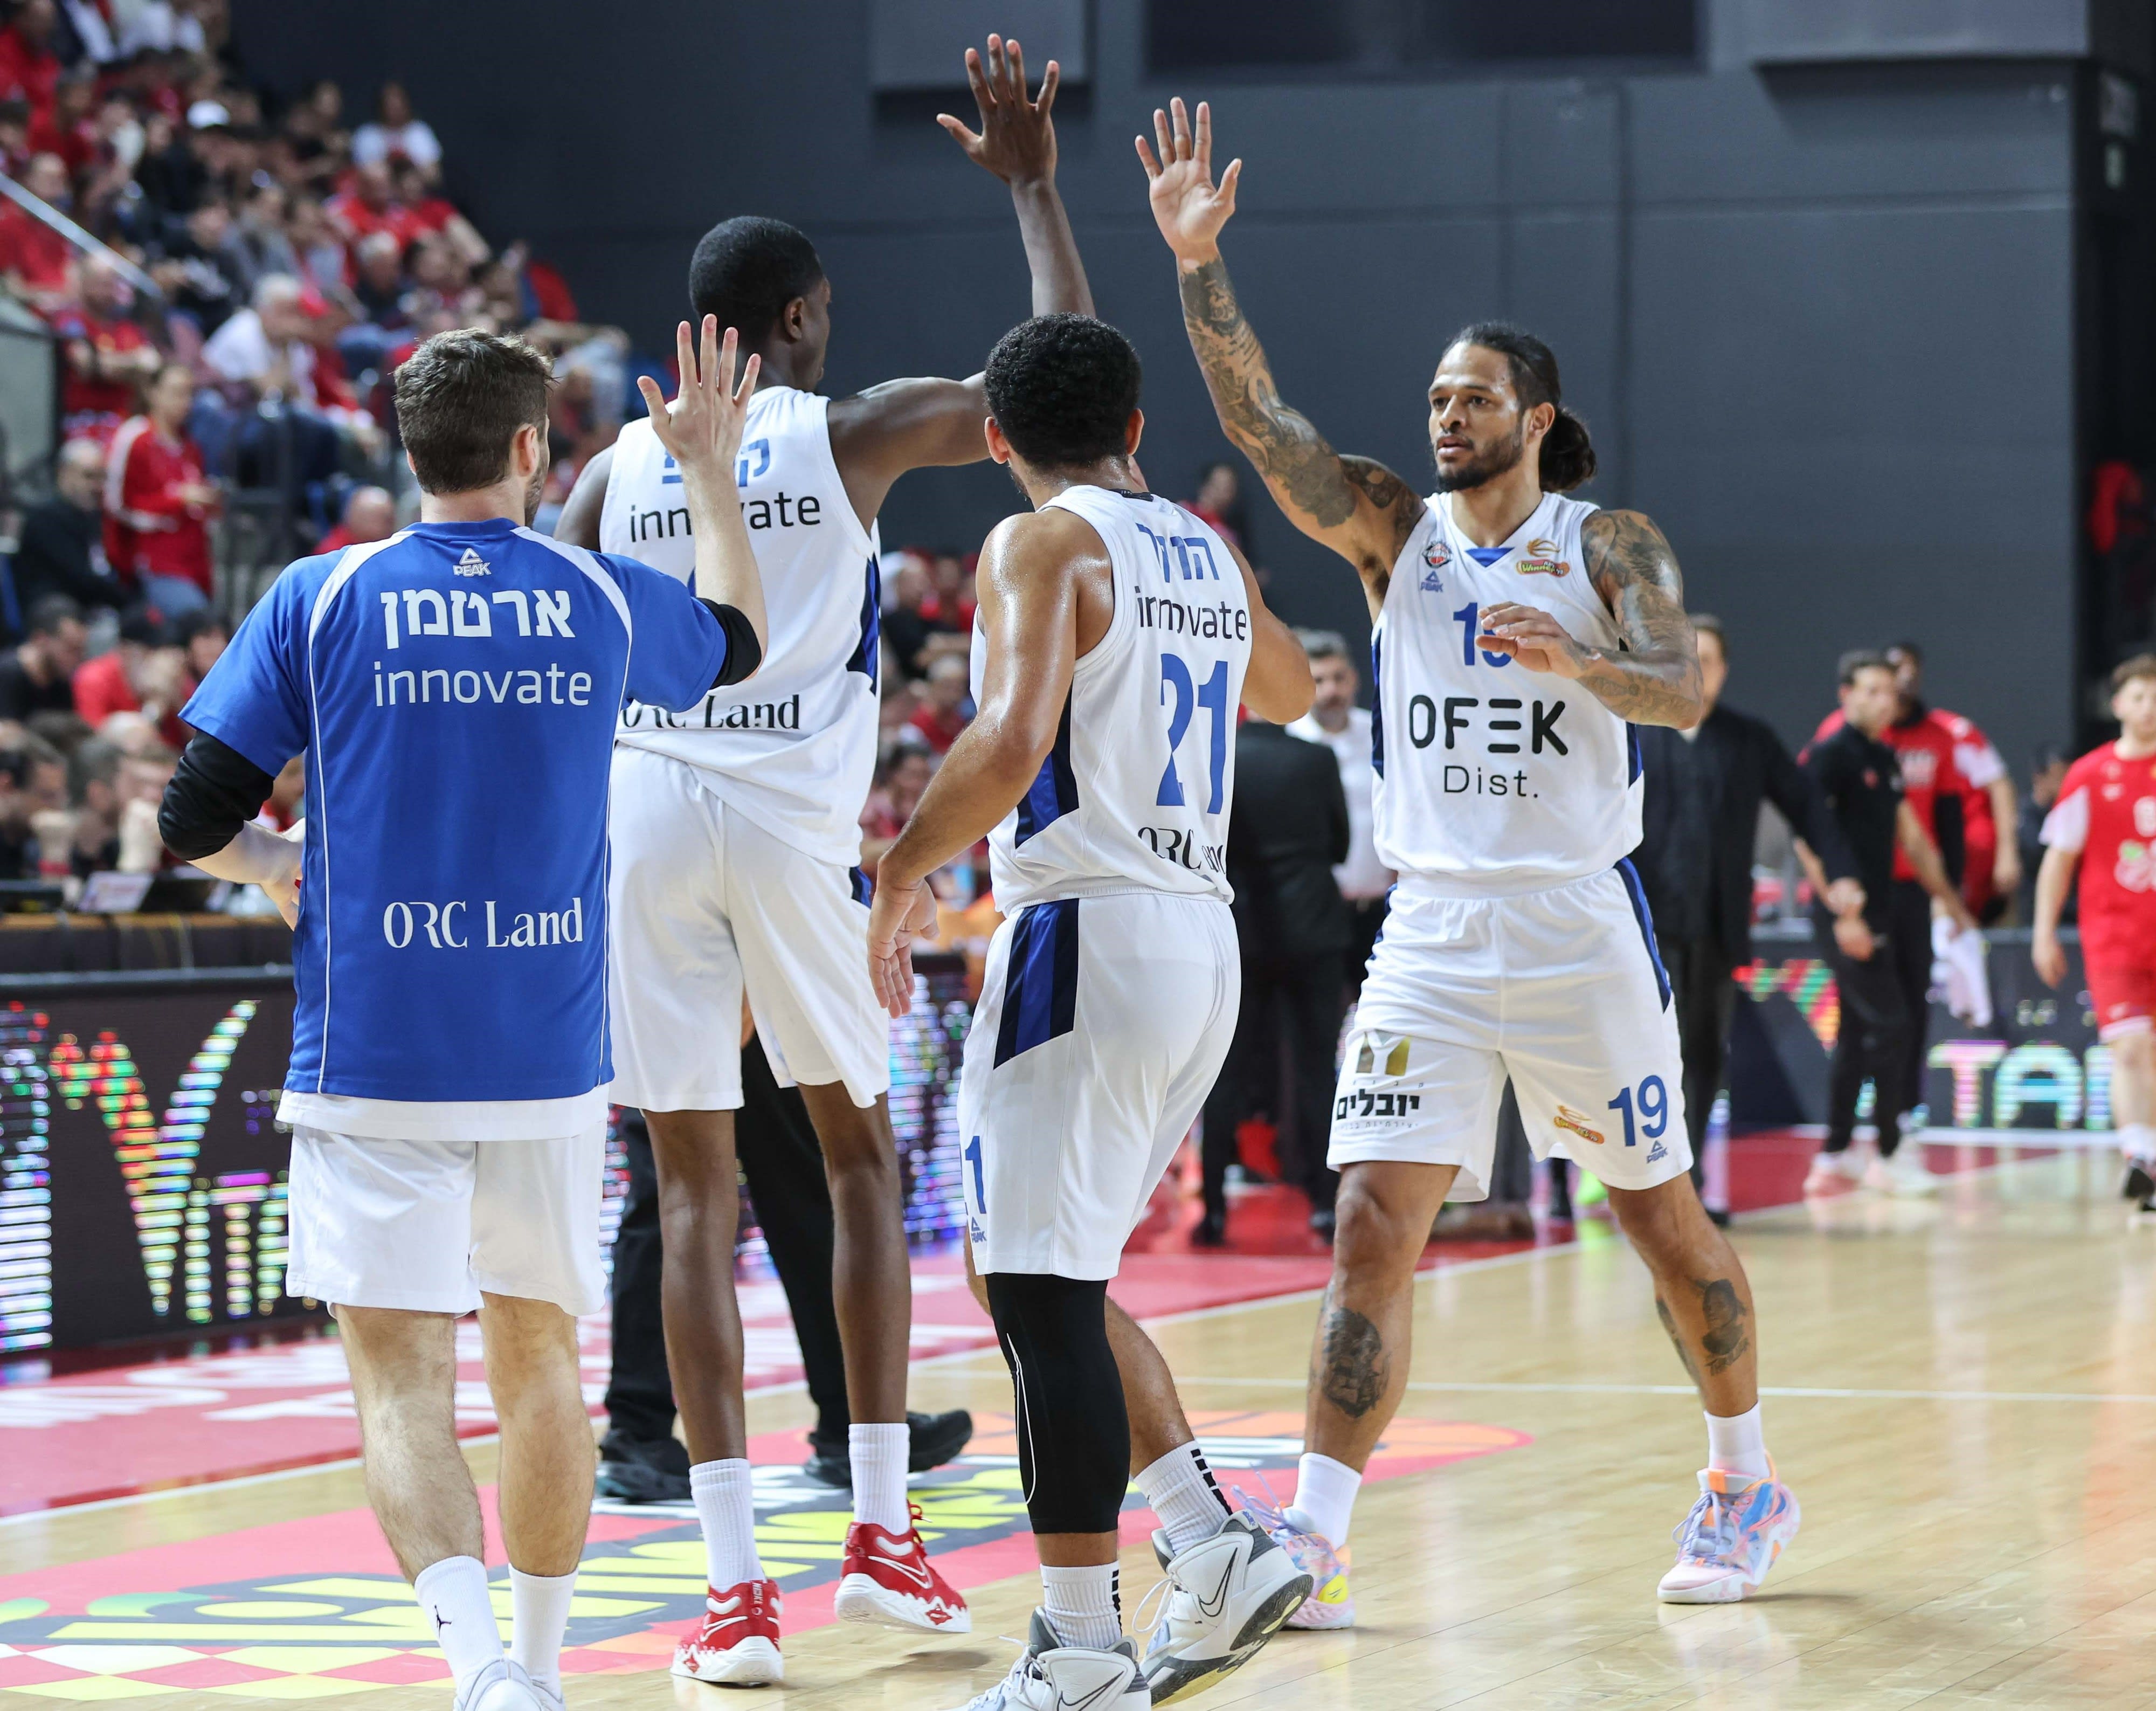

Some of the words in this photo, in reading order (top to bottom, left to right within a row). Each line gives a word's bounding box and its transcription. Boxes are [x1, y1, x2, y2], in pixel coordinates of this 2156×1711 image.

[631, 492, 820, 542] innate
[453, 562, 492, 577] PEAK
[380, 589, 576, 650] ארטמן
[374, 661, 592, 707] innovate
[703, 694, 800, 729] Land
[1156, 653, 1228, 814] 21
[1409, 695, 1568, 756] OFEK
[1444, 765, 1538, 798] Dist.
[383, 901, 468, 948] ORC
[485, 898, 584, 948] Land
[1336, 1088, 1420, 1121] יובלים
[1608, 1075, 1668, 1147] 19
[965, 1136, 987, 1215] 1
